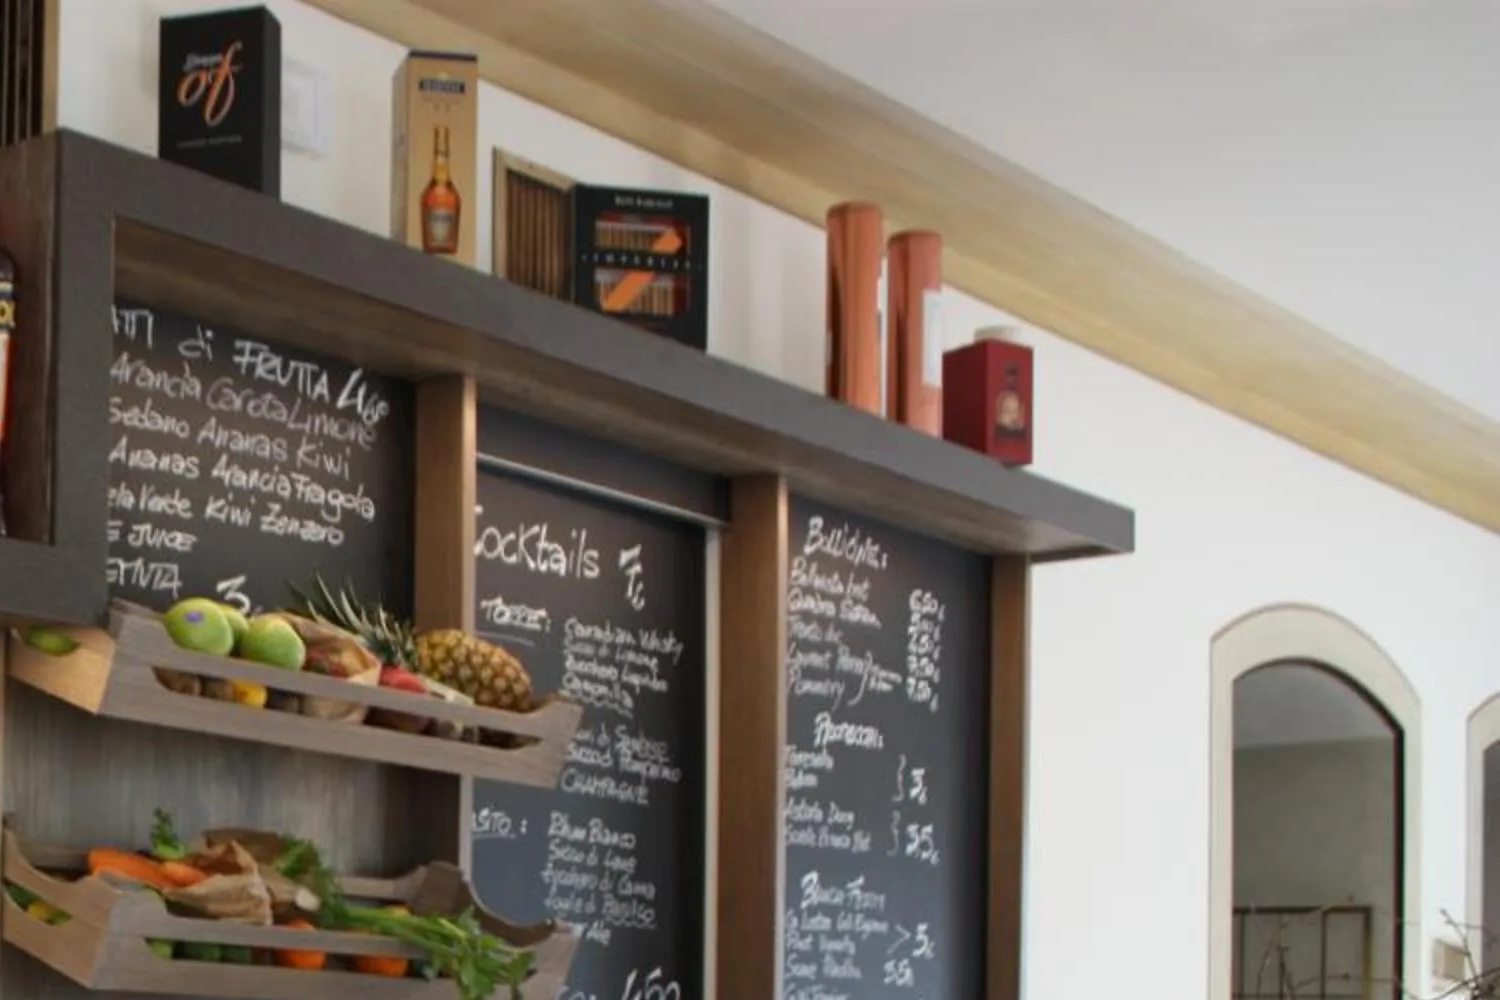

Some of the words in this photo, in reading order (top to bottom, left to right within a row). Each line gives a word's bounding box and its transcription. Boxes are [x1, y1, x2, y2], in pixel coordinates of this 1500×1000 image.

[110, 351, 202, 400] Arancia
[206, 377, 287, 424] Carota
[287, 398, 377, 452] Limone
[178, 322, 213, 361] di
[233, 338, 329, 402] FRUTTA
[108, 397, 190, 438] Sedano
[197, 415, 287, 462] Ananas
[296, 436, 350, 480] Kiwi
[108, 435, 199, 478] Ananas
[211, 453, 291, 499] Arancia
